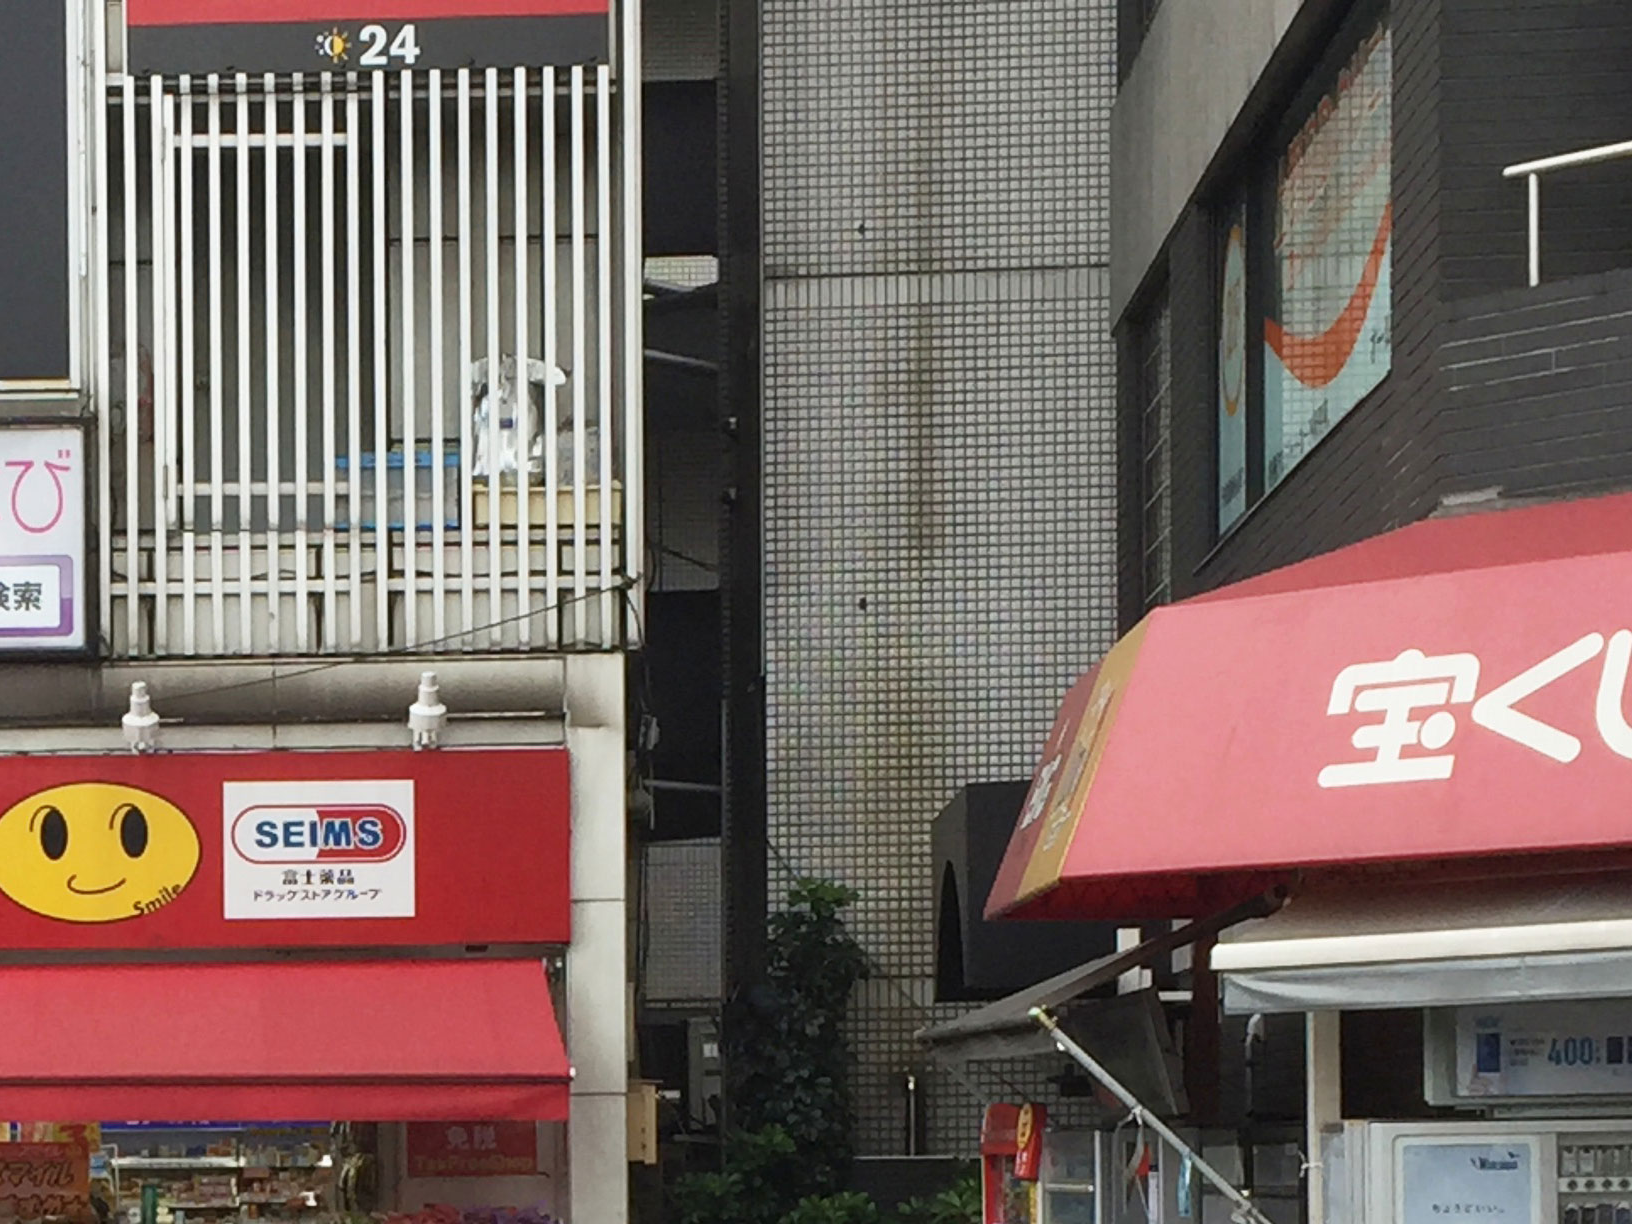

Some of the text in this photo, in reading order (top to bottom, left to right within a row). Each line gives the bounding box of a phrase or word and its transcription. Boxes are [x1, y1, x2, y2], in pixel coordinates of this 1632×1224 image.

[358, 23, 421, 66] 24
[254, 818, 384, 849] SEIMS
[281, 868, 355, 886] 富士薬品
[132, 882, 182, 917] Smile
